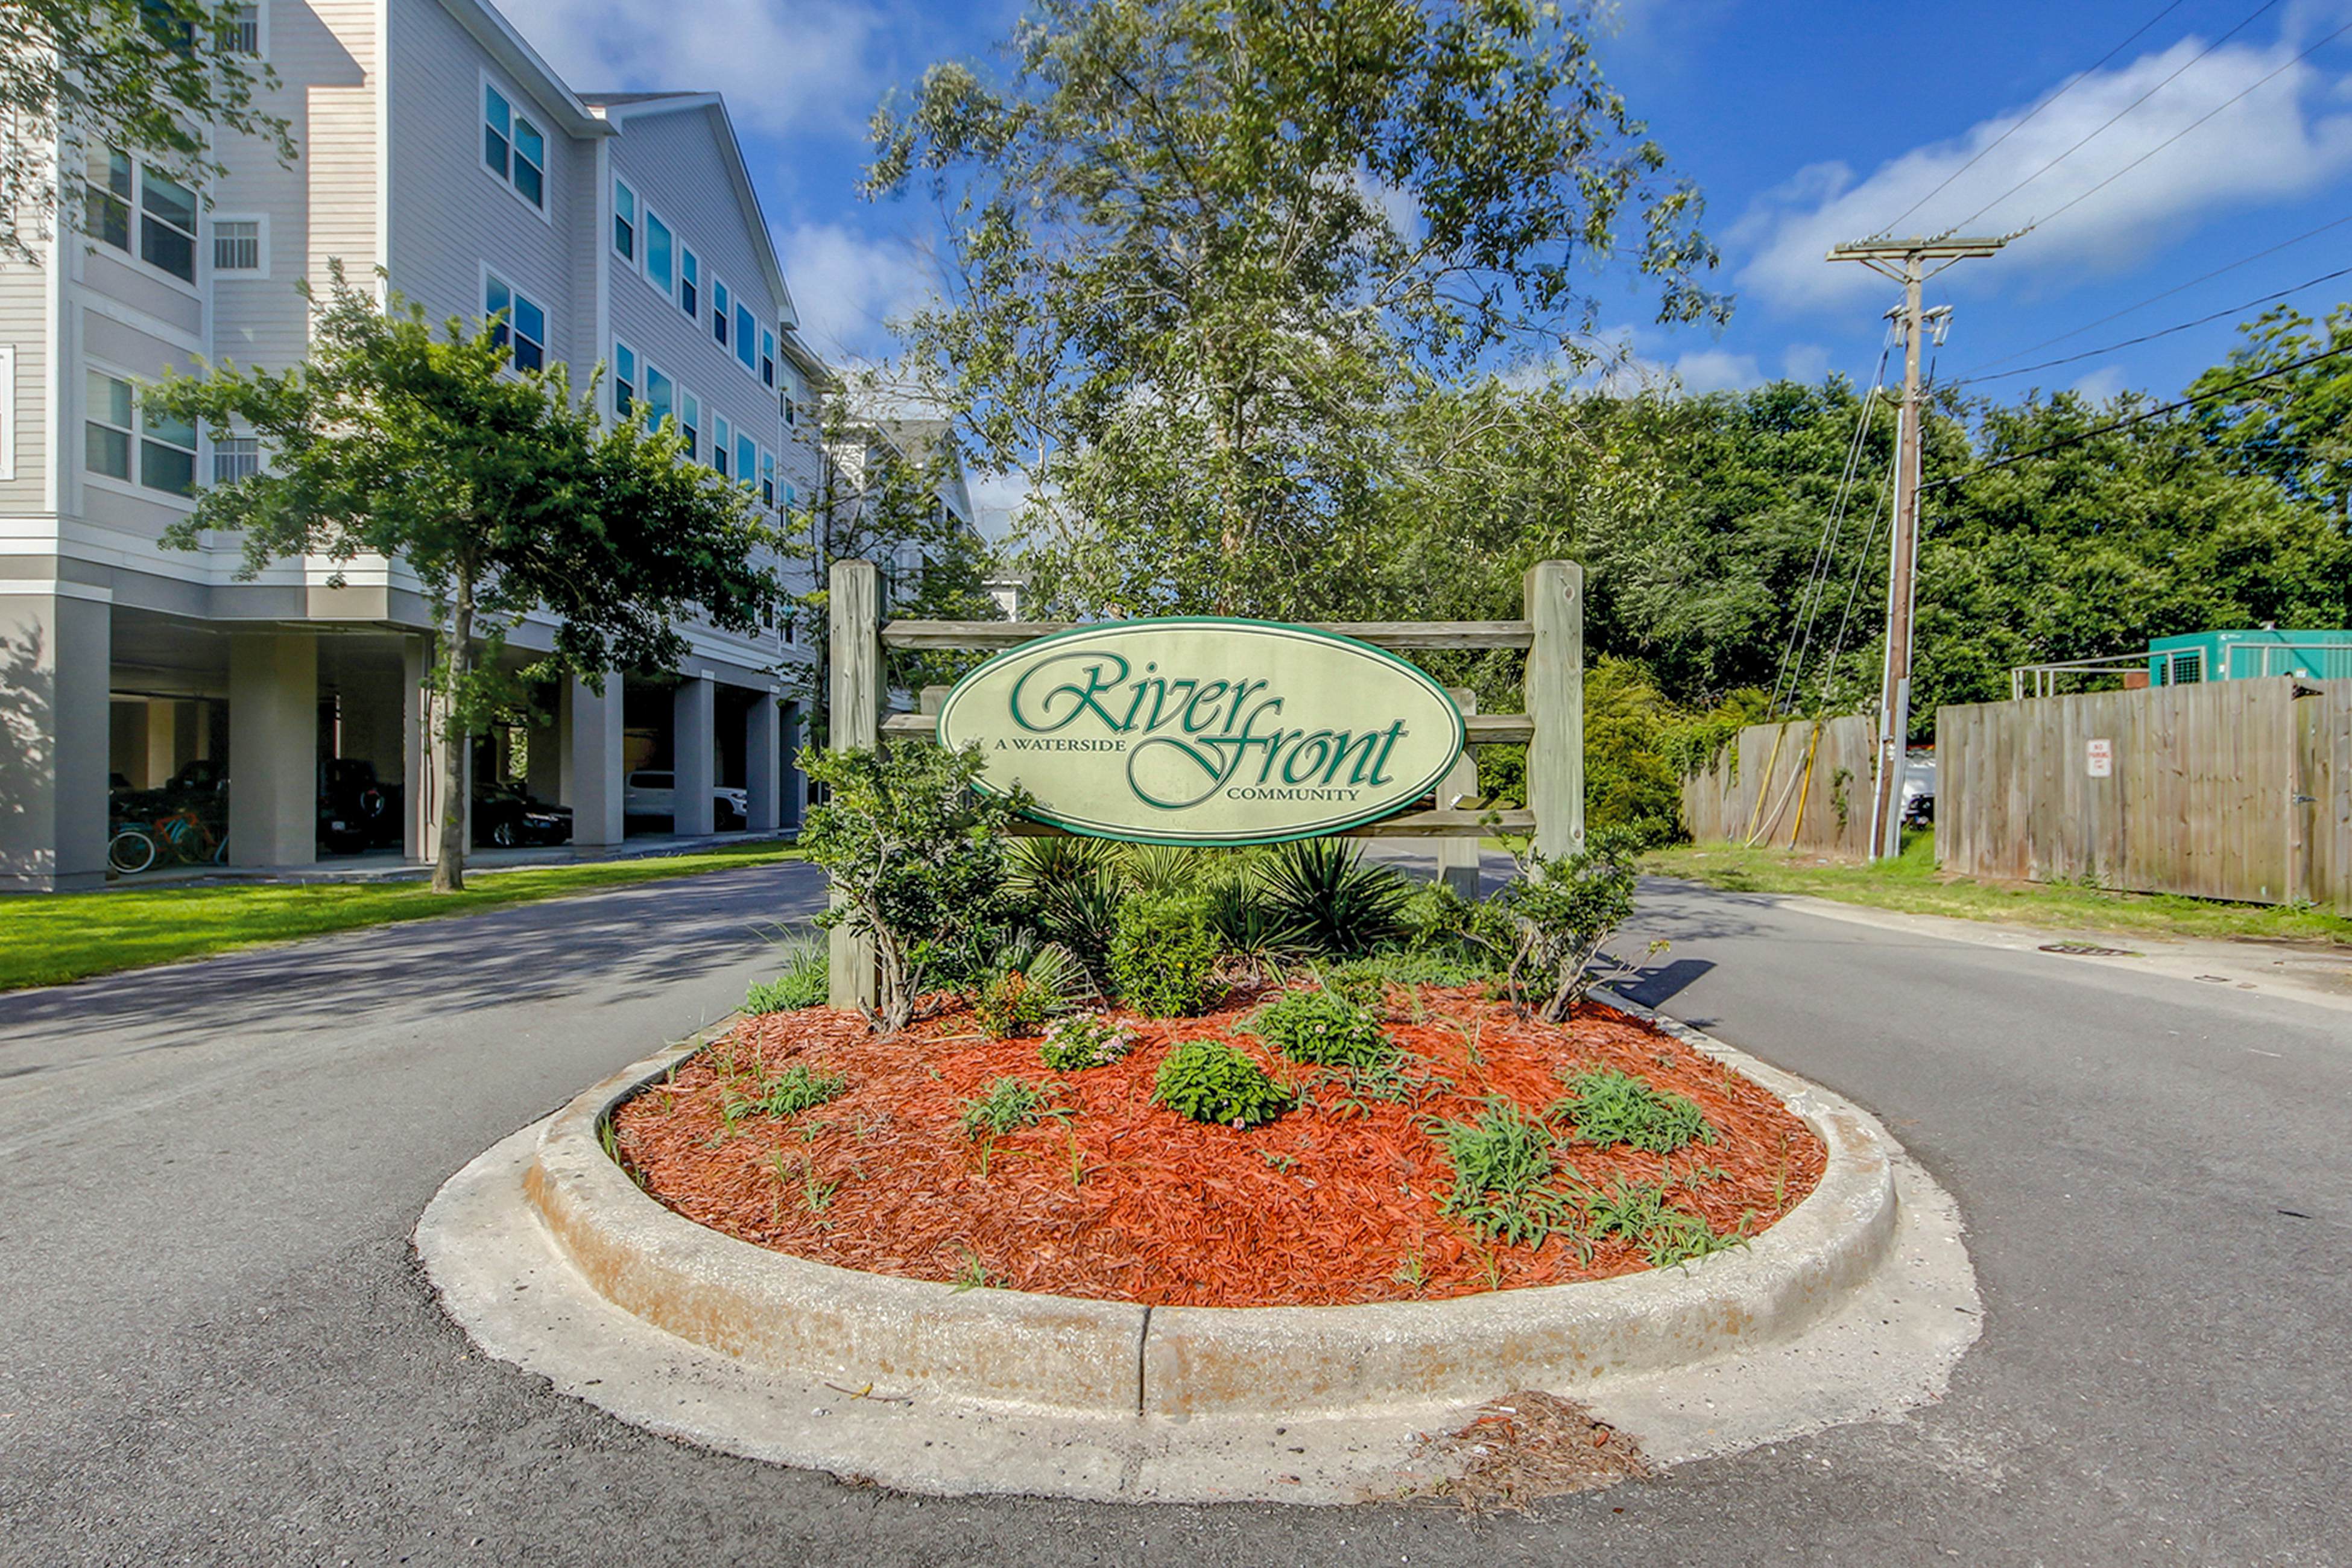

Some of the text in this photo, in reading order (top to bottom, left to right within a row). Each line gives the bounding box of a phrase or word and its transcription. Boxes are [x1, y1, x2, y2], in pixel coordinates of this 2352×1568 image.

[1008, 650, 1269, 735] River
[994, 738, 1127, 752] A WATERSIDE
[1226, 787, 1360, 801] COMMUNITY
